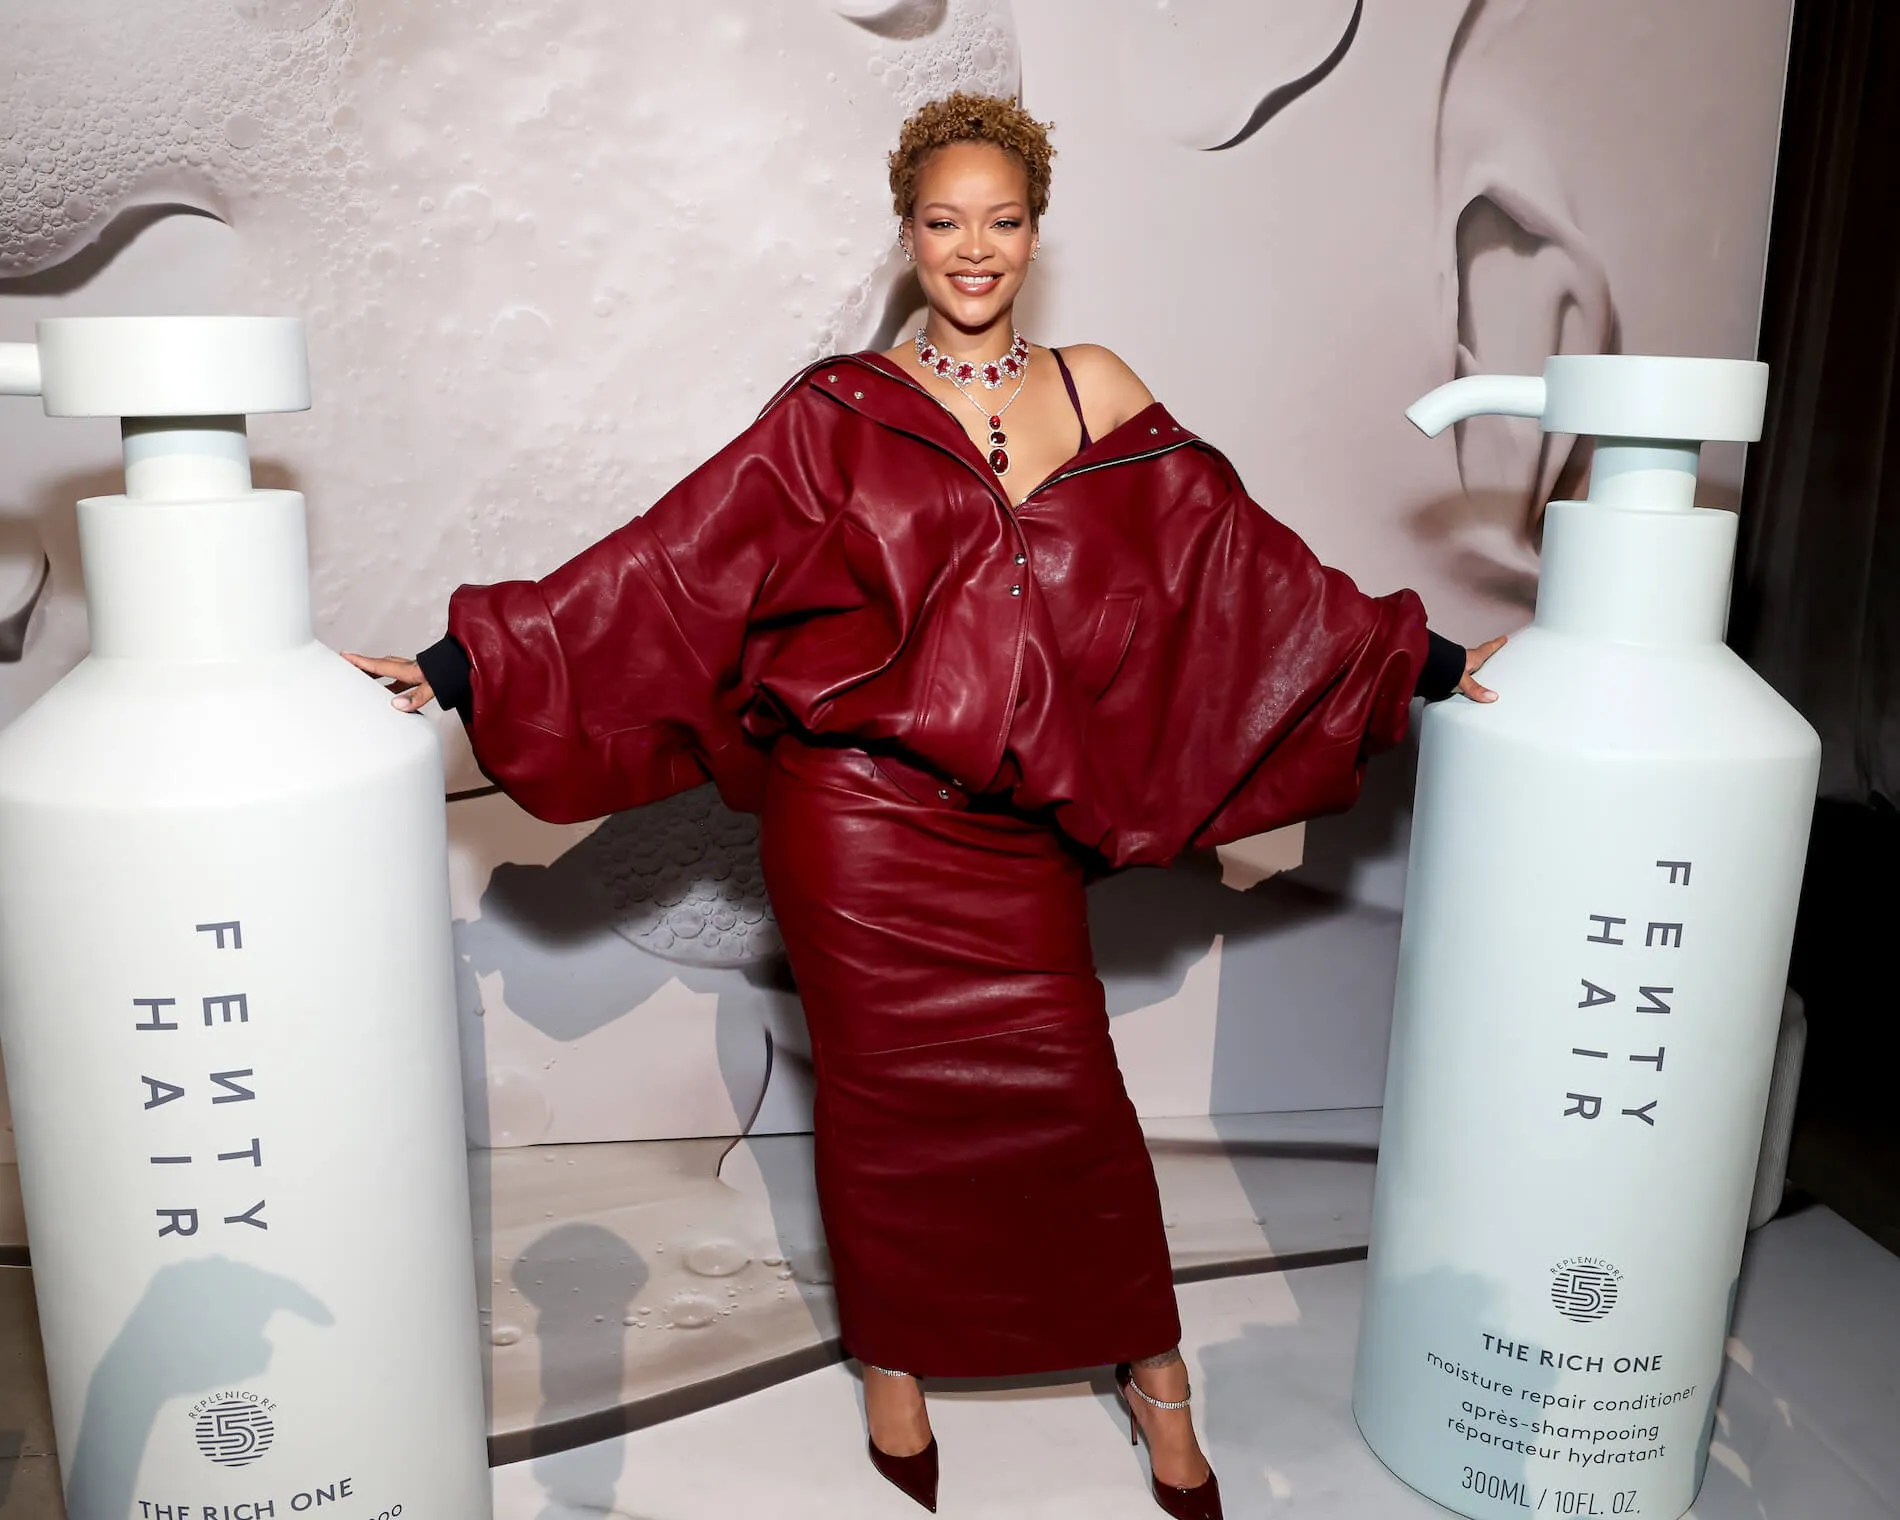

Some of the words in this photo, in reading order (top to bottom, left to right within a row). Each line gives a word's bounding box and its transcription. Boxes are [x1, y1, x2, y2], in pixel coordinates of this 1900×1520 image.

[1563, 914, 1627, 1120] HAIR
[132, 997, 200, 1239] HAIR
[1550, 1256, 1624, 1282] REPLENICORE
[1482, 1332, 1530, 1362] THE
[1539, 1349, 1604, 1373] RICH
[1613, 1354, 1663, 1373] ONE
[188, 1390, 277, 1419] REPLENICORE
[1426, 1351, 1514, 1396] moisture
[1521, 1388, 1587, 1409] repair
[1592, 1384, 1697, 1411] conditioner
[1447, 1416, 1561, 1461] réparateur
[1567, 1444, 1666, 1468] hydratant
[1461, 1400, 1660, 1445] après-shampooing
[138, 1500, 190, 1520] THE
[203, 1500, 275, 1520] RICH
[290, 1477, 353, 1511] ONE
[1461, 1466, 1531, 1508] 300ML
[1554, 1490, 1604, 1515] 10FL.
[1611, 1490, 1641, 1514] OZ.
